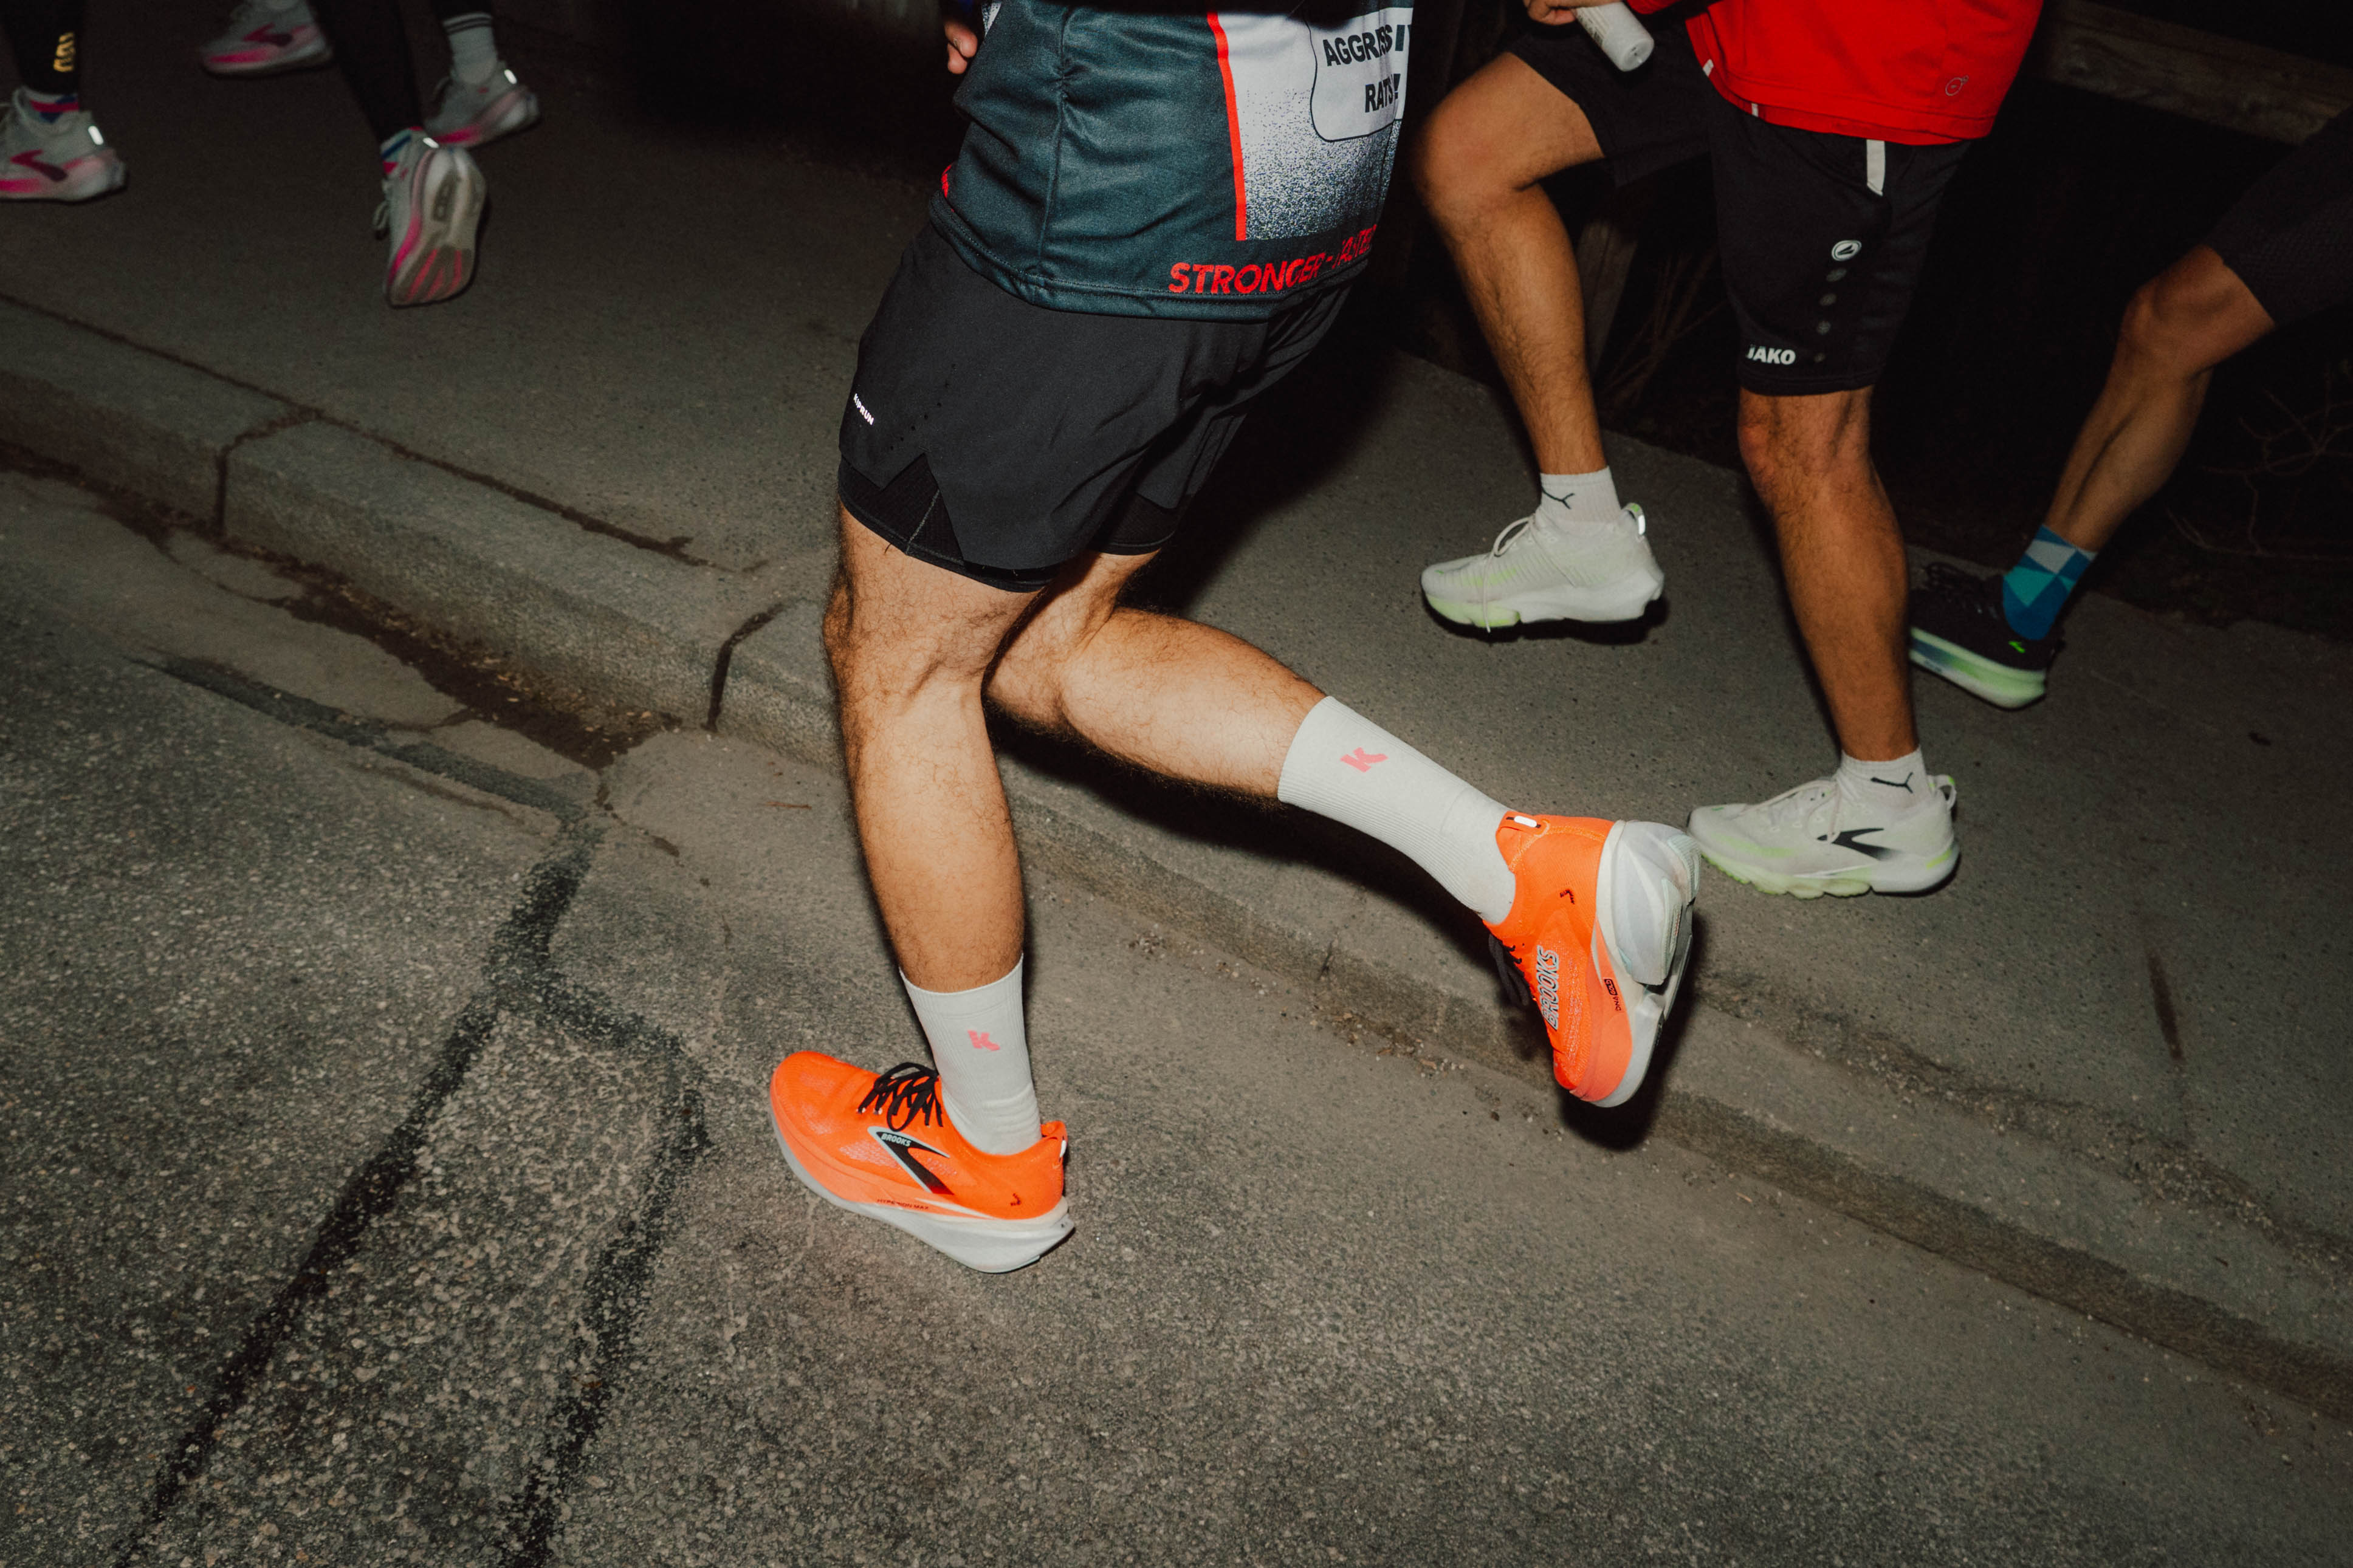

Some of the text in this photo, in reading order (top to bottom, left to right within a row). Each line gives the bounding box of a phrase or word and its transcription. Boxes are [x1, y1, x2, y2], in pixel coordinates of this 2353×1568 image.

[1322, 24, 1412, 67] AGGRSSI
[1168, 252, 1326, 294] STRONGER
[1747, 344, 1796, 365] JAKO
[1536, 945, 1559, 1031] BROOKS
[1612, 996, 1622, 1012] DNA
[881, 1132, 912, 1148] BROOKS
